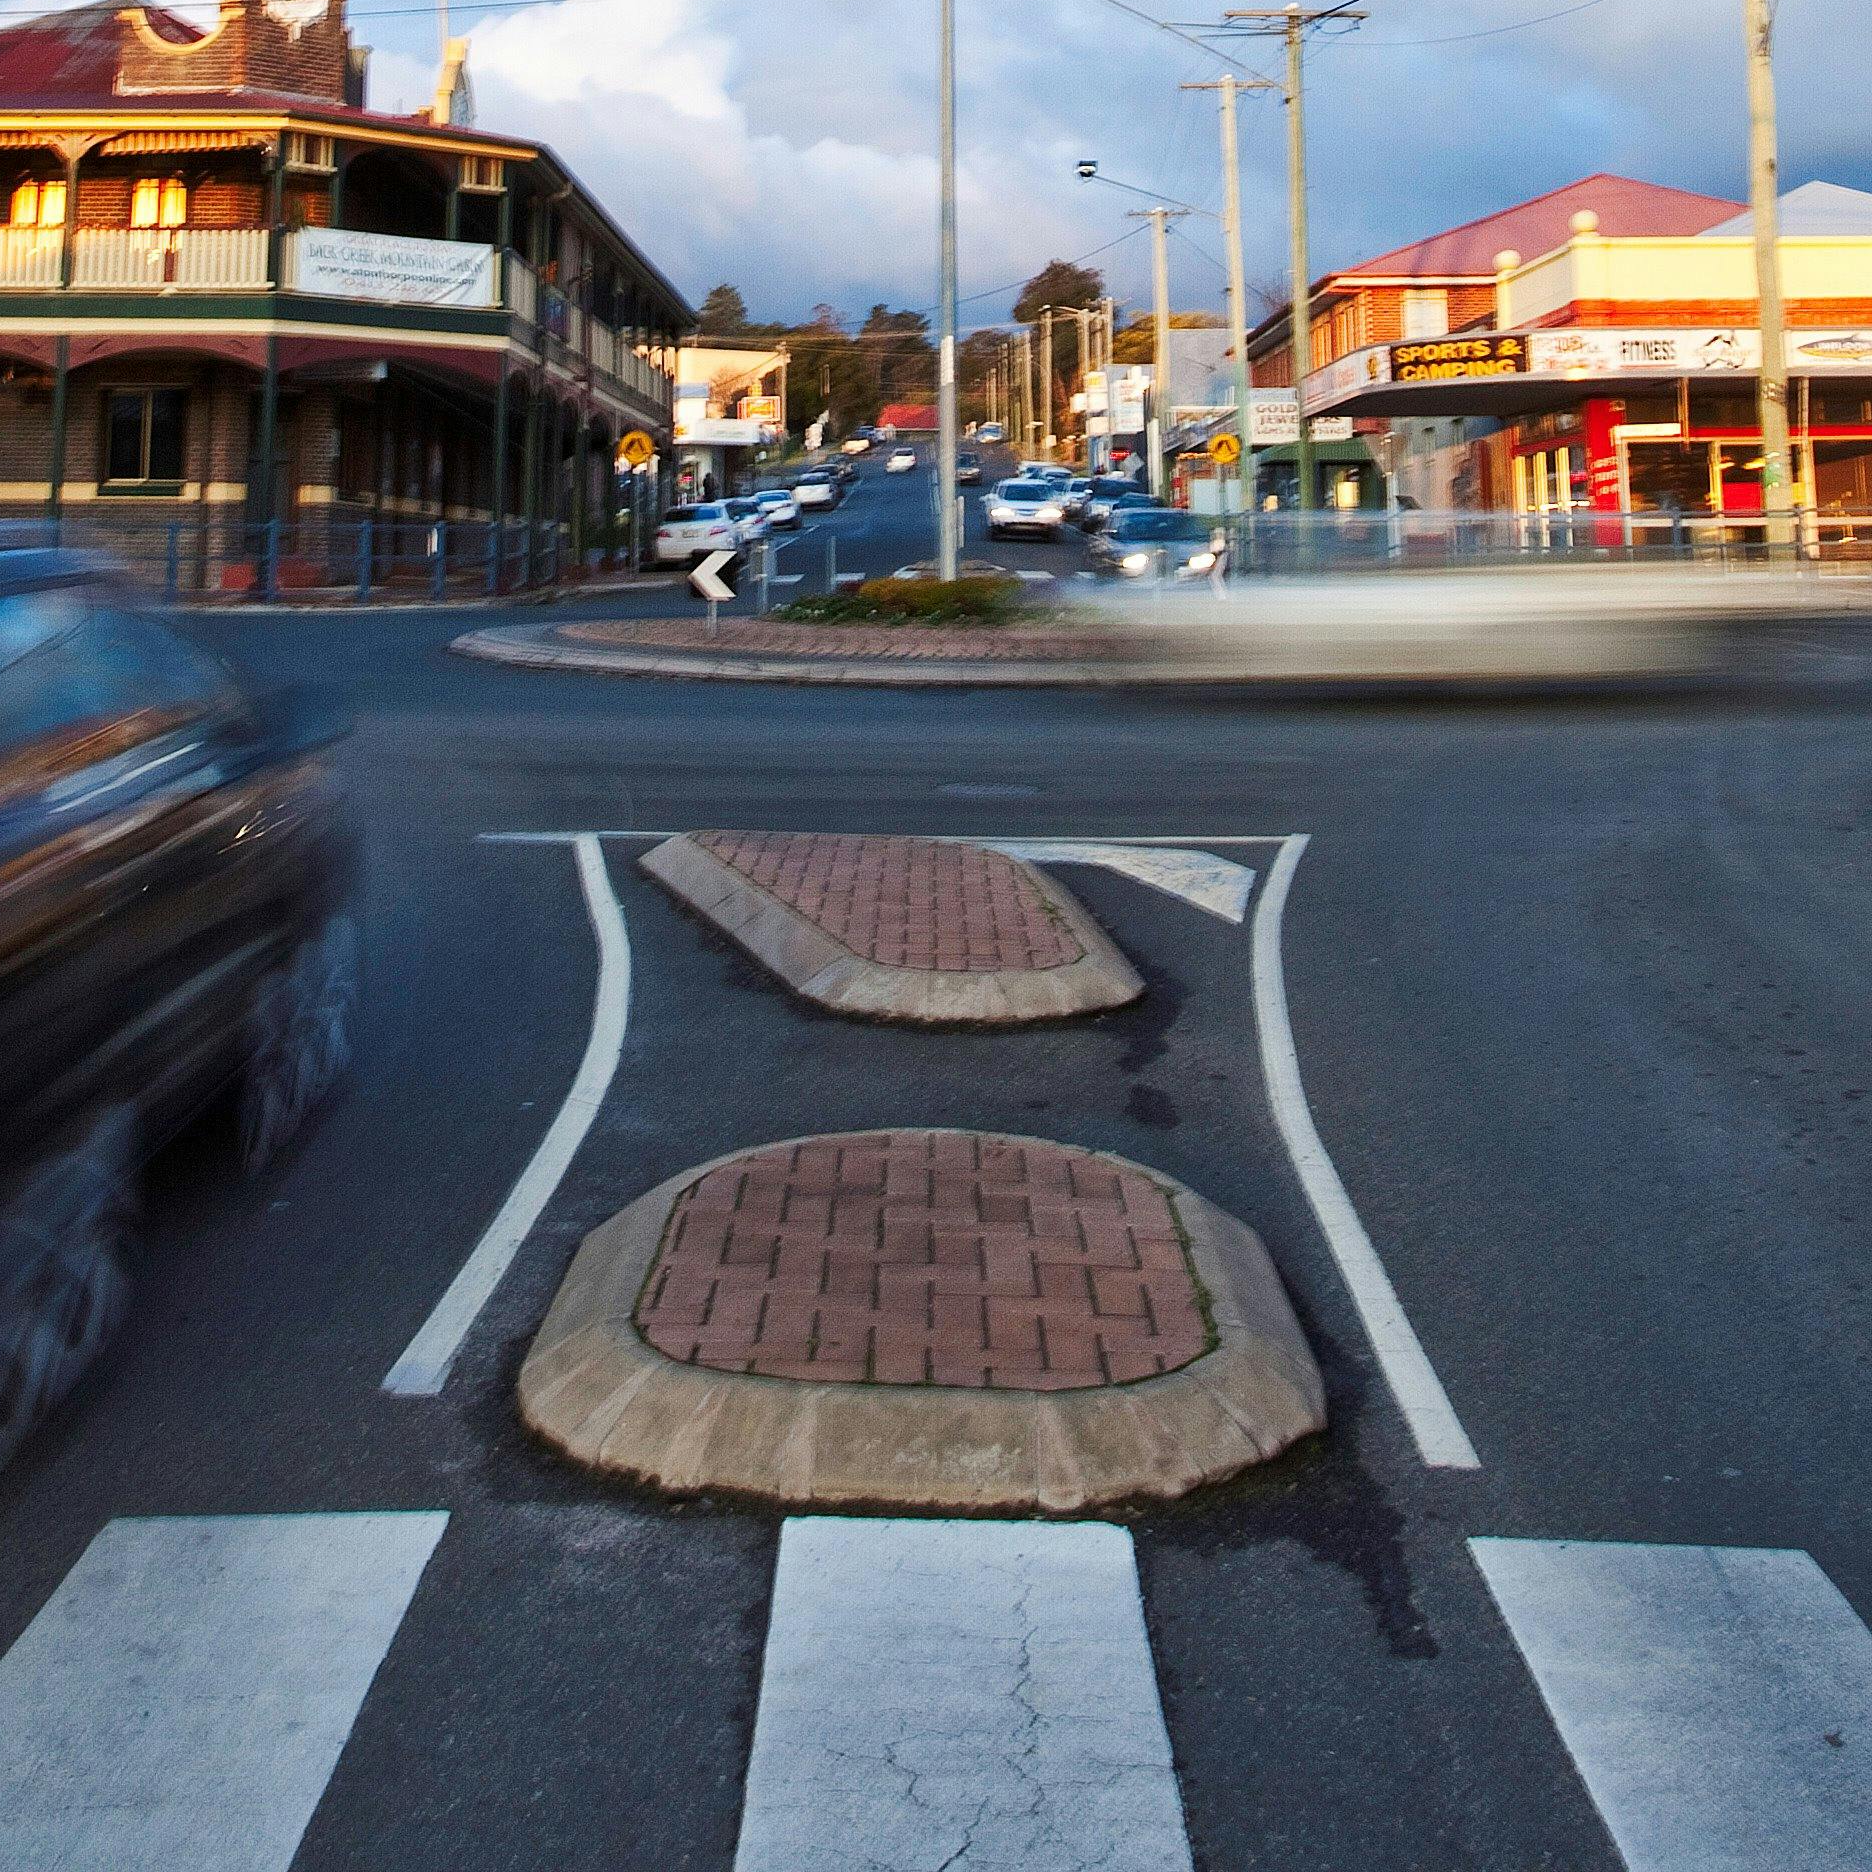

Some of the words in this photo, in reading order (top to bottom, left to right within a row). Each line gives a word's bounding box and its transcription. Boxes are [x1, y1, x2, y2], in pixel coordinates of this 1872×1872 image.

[1394, 340, 1491, 364] SPORTS
[1497, 339, 1524, 356] &
[1396, 359, 1516, 382] CAMPING
